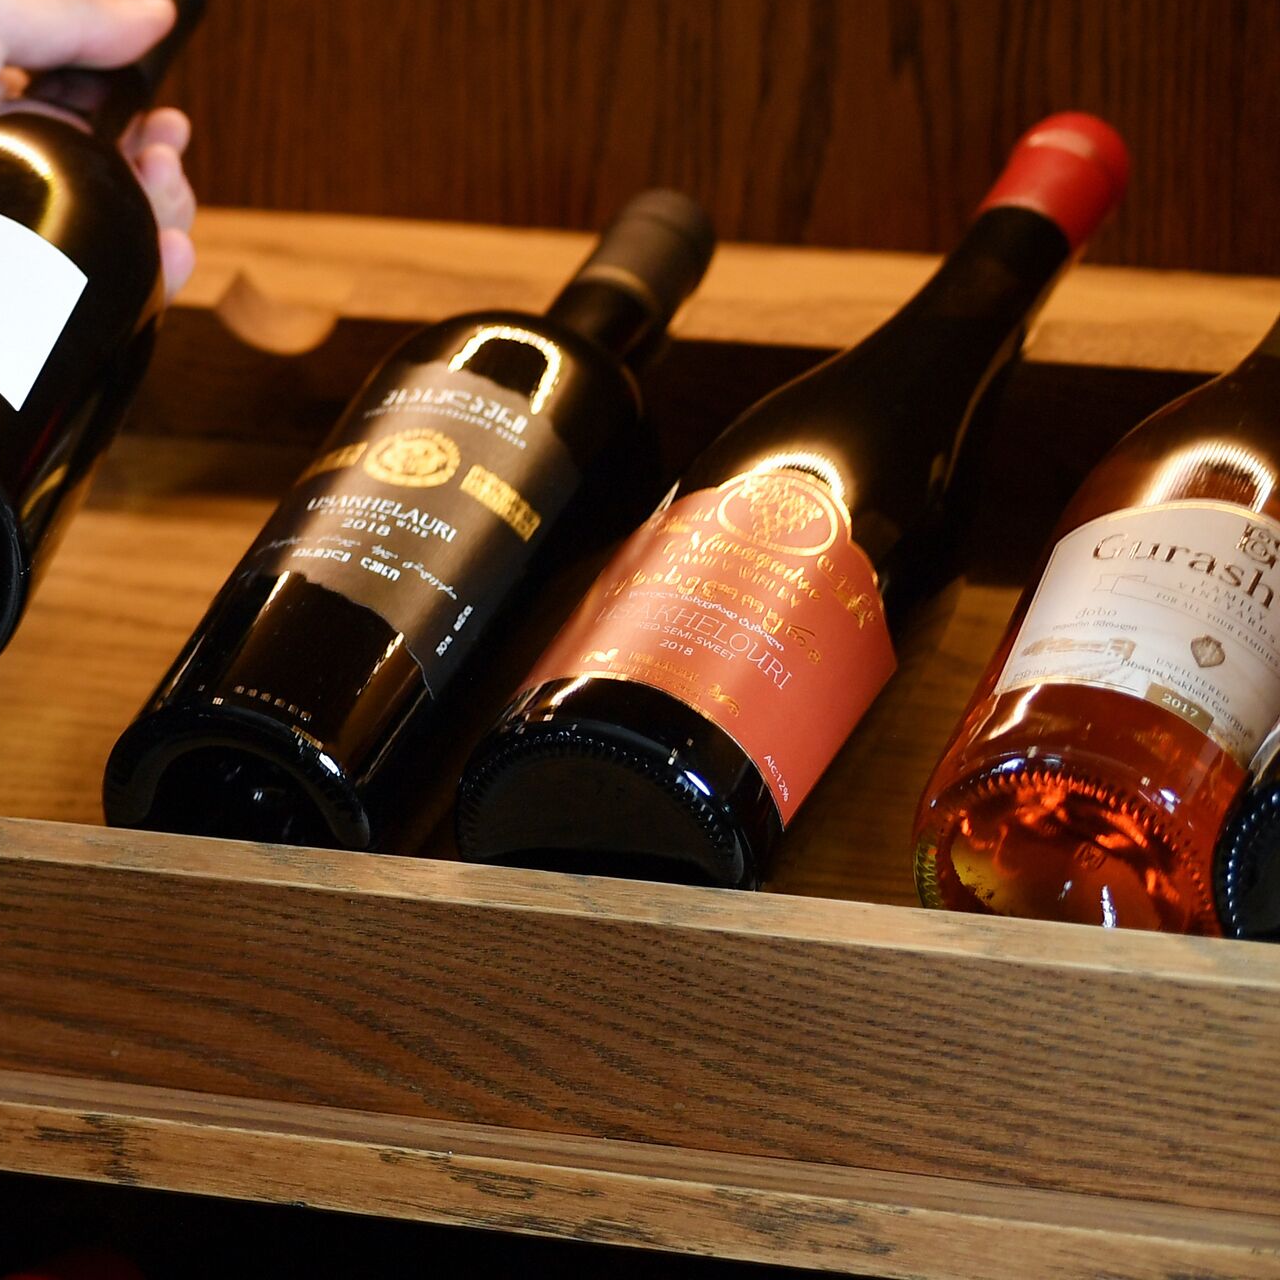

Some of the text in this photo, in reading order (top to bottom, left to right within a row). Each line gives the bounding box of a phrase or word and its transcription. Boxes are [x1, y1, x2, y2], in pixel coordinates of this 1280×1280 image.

[306, 494, 457, 543] USAKHELAURI
[341, 517, 391, 537] 2018
[395, 518, 429, 538] WINE
[1092, 533, 1280, 609] Gurash
[659, 638, 694, 657] 2018
[663, 625, 737, 661] SEMI-SWEET
[1155, 657, 1230, 704] UNFILTERED
[1166, 671, 1211, 704] Kakheti
[1161, 692, 1200, 718] 2017
